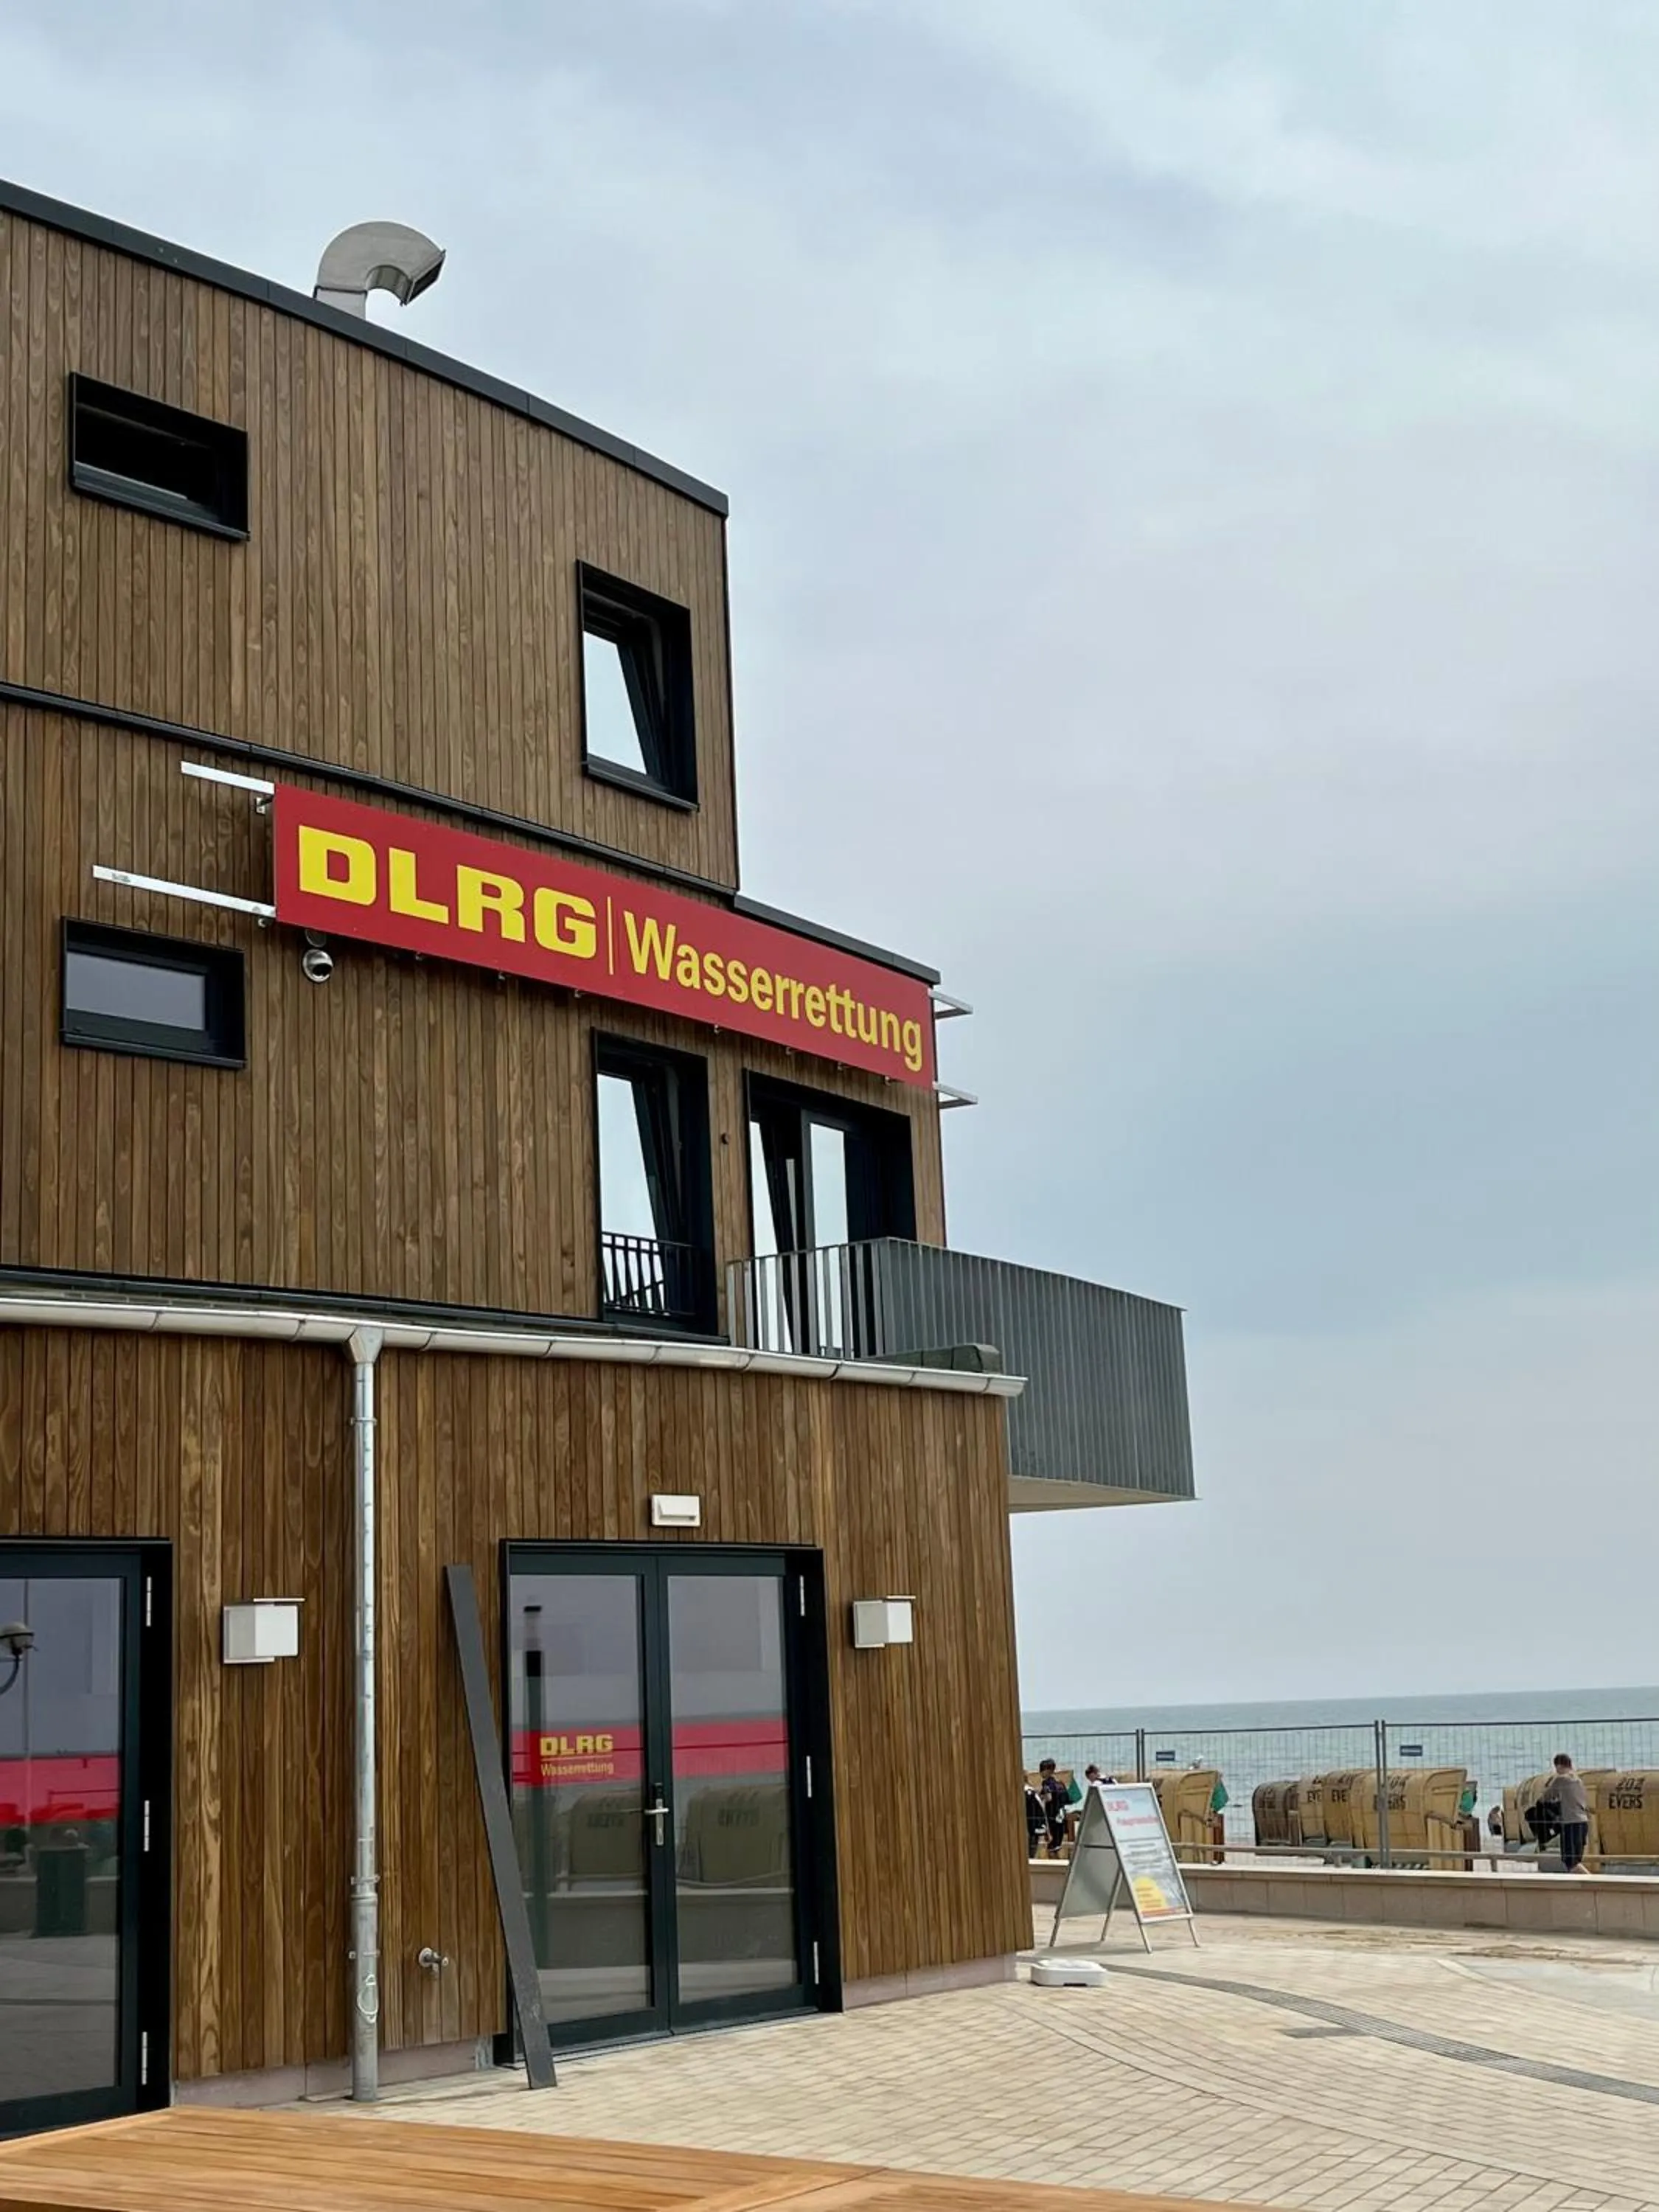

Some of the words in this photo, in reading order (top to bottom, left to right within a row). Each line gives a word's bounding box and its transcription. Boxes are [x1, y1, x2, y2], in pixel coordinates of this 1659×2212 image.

[299, 825, 597, 959] DLRG
[623, 910, 923, 1073] Wasserrettung
[540, 1733, 613, 1755] DLRG
[1609, 1792, 1644, 1809] EVERS
